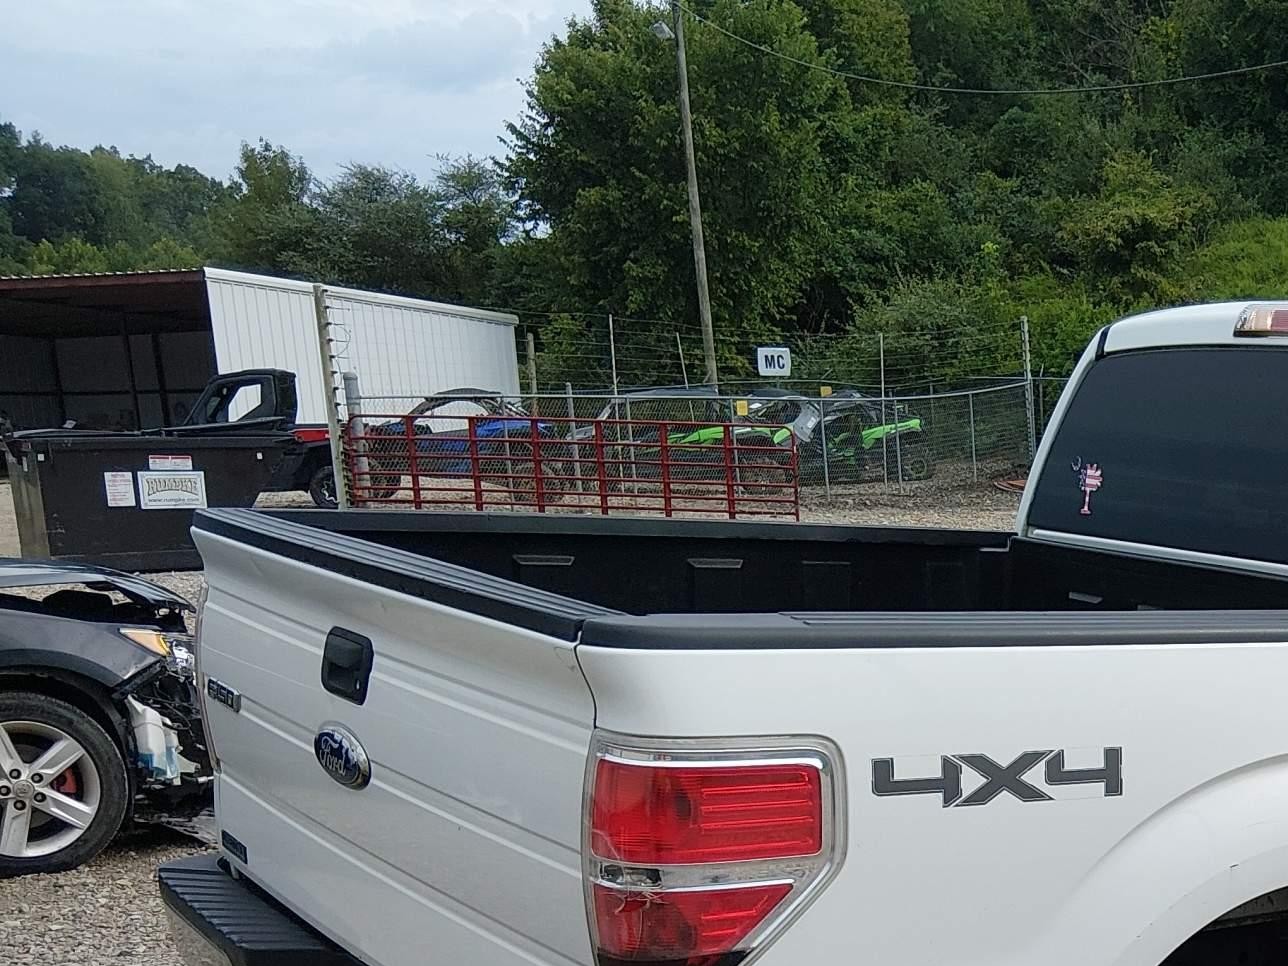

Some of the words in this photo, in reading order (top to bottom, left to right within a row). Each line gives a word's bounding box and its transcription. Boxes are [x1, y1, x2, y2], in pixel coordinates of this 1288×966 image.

[764, 354, 785, 369] MC
[145, 478, 199, 496] RUMPKE
[319, 735, 347, 777] Ford
